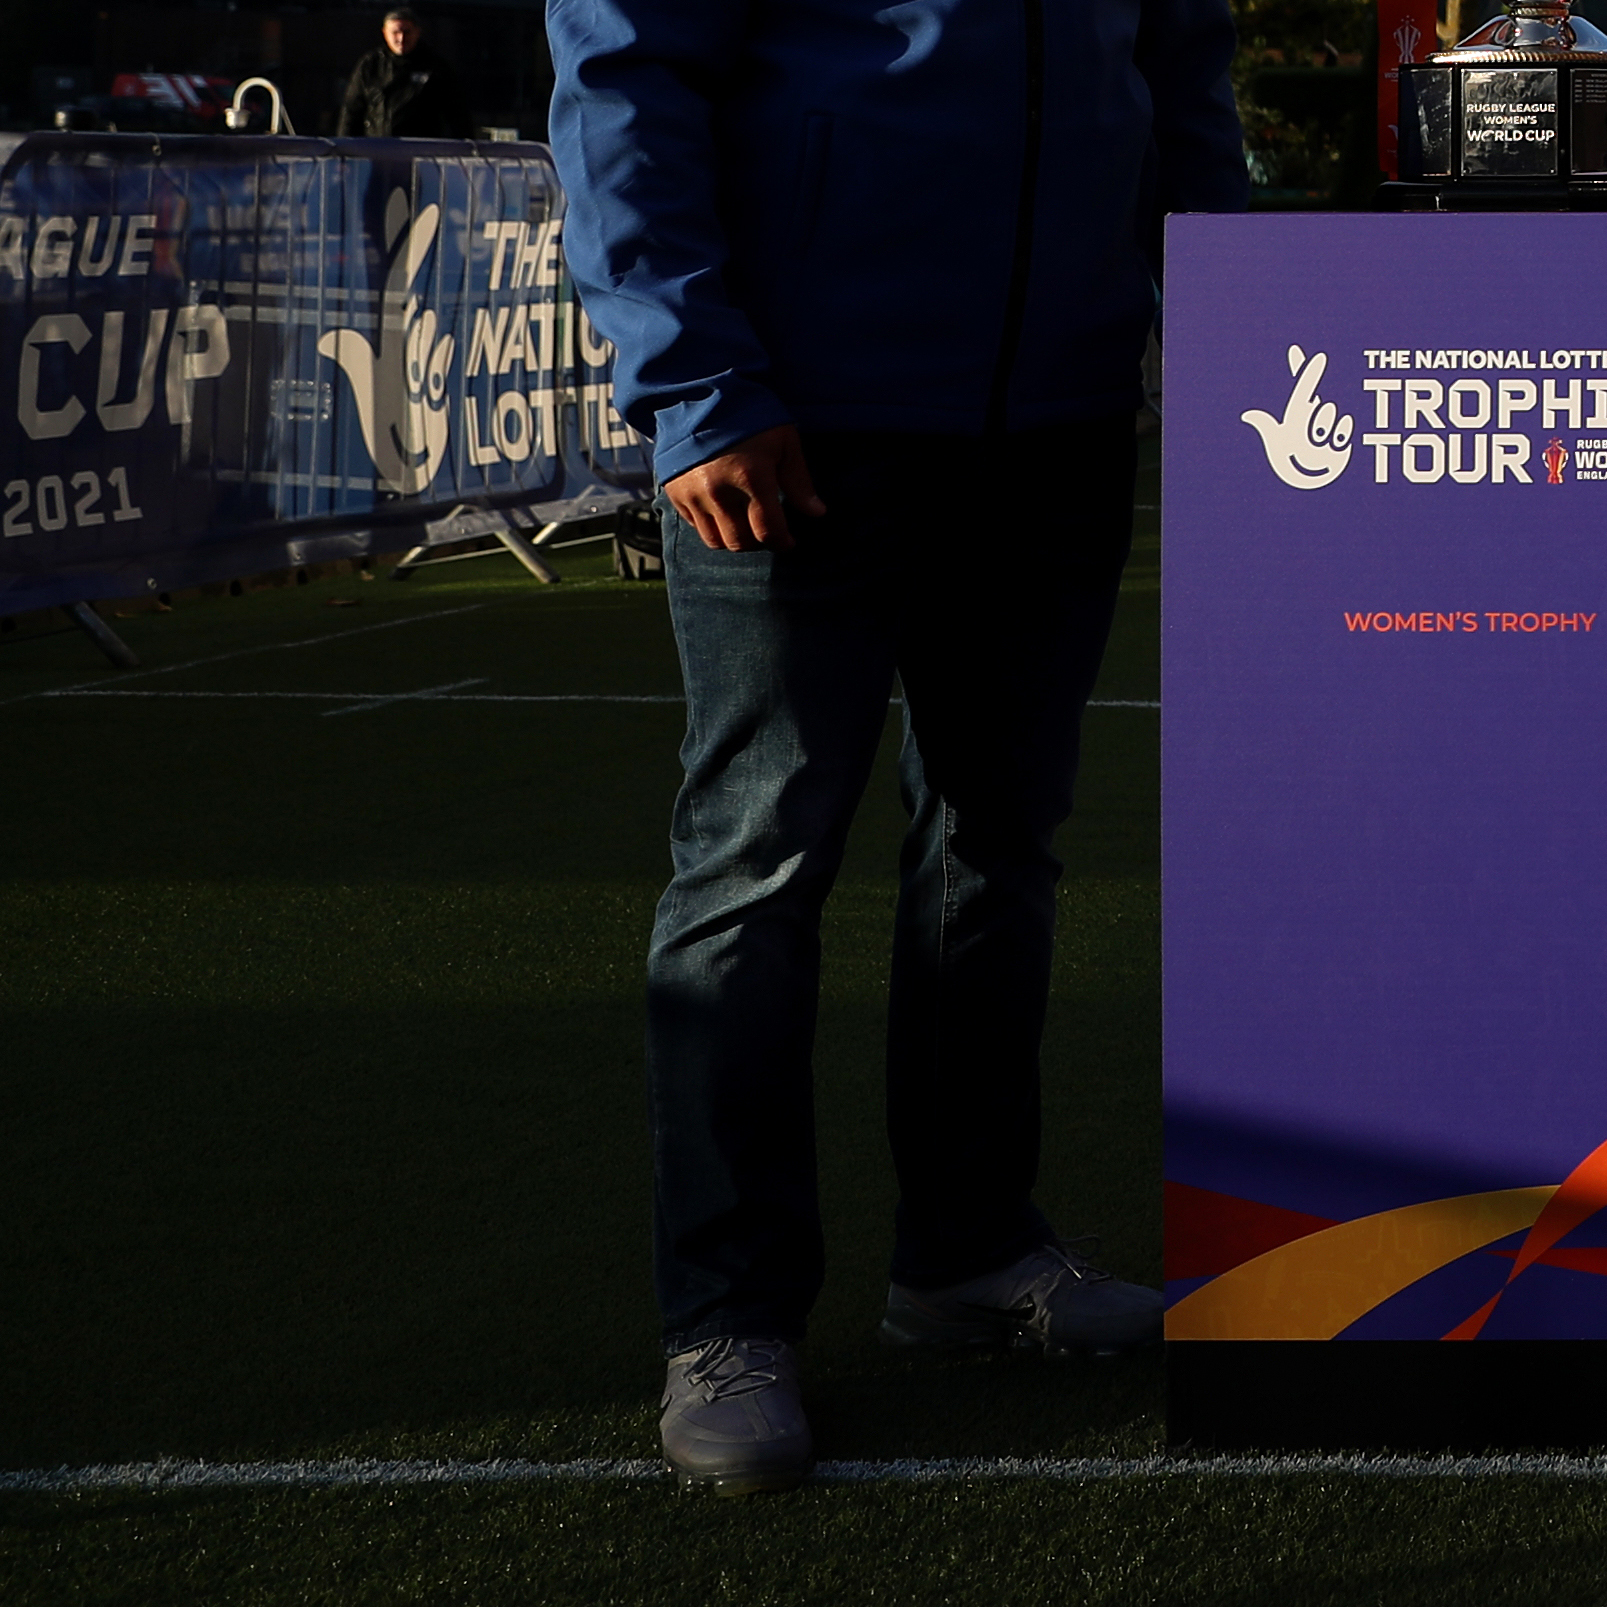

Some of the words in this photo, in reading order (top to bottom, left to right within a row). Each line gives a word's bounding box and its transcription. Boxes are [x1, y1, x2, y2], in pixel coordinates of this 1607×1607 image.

[1466, 103, 1507, 113] RUGBY
[1508, 103, 1556, 113] LEAGUE
[1483, 115, 1539, 125] WOMEN'S
[1467, 129, 1524, 142] WORLD
[1525, 129, 1556, 142] CUP
[482, 219, 563, 291] THE
[16, 302, 231, 441] CUP
[1363, 349, 1410, 369] THE
[1415, 349, 1536, 370] NATIONAL
[465, 382, 640, 467] LOTTE
[1362, 433, 1534, 484] TOUR
[2, 466, 143, 538] 2021
[1344, 611, 1478, 632] WOMEN'S
[1484, 612, 1597, 633] TROPHY
